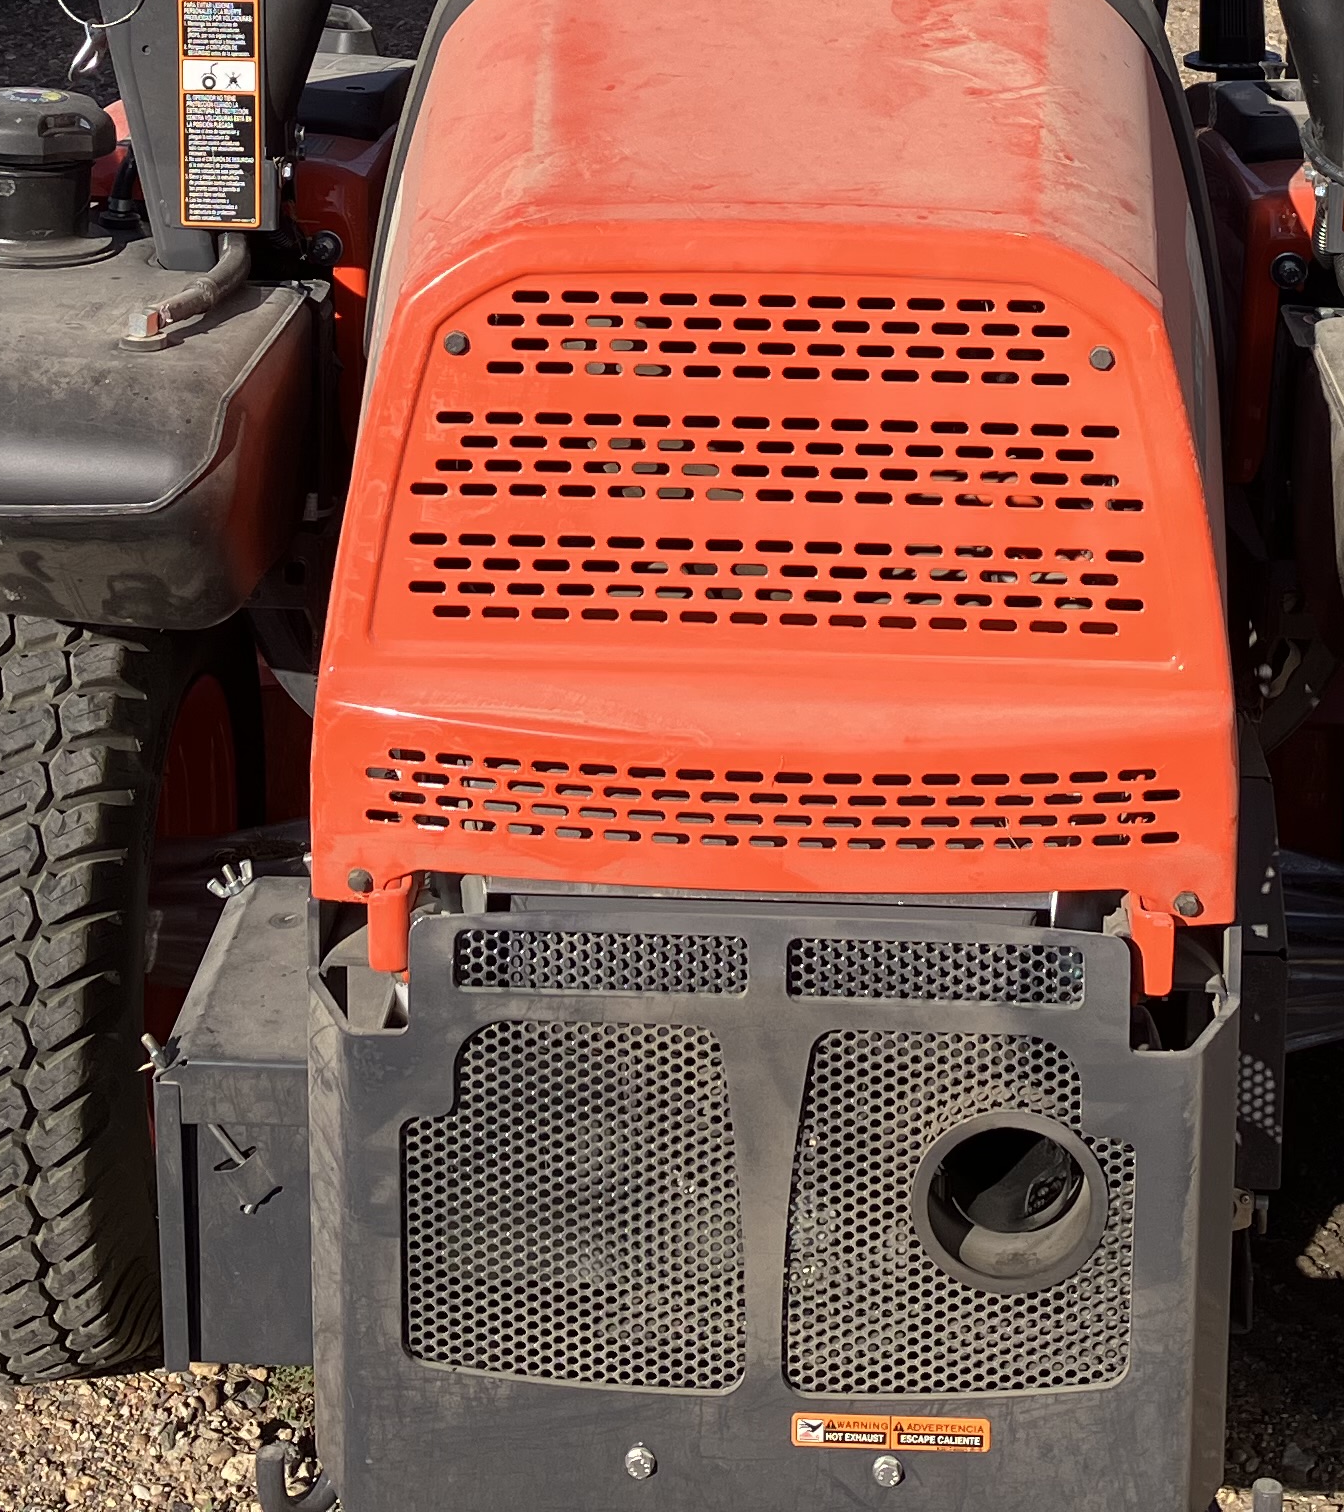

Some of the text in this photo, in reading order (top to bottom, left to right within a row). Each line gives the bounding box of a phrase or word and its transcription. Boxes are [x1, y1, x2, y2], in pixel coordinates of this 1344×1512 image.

[837, 1421, 889, 1431] WARNING
[906, 1423, 985, 1434] ADVERTENCIA
[825, 1431, 885, 1443] HOT EXHAUST
[900, 1434, 982, 1446] ESCAPE CALIENTE
